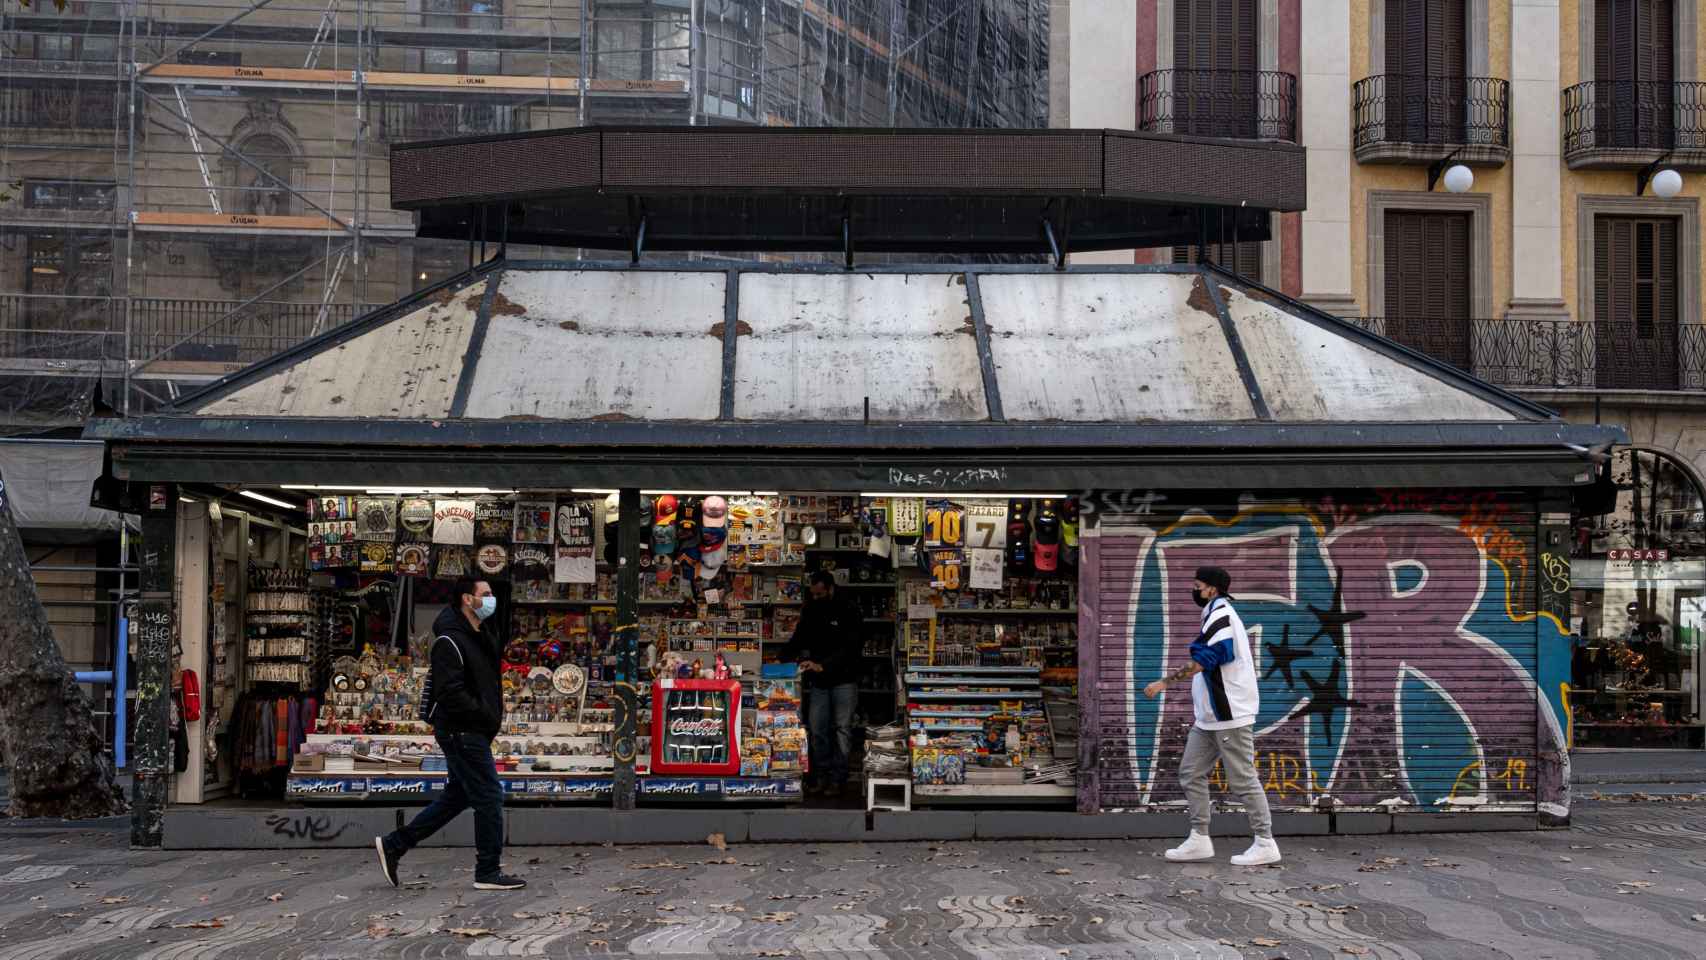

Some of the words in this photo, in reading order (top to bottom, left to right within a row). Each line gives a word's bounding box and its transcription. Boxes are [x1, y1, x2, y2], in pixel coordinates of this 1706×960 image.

[926, 510, 961, 545] 10
[975, 522, 996, 548] 7
[1609, 550, 1666, 559] CASAS
[933, 565, 960, 590] 10
